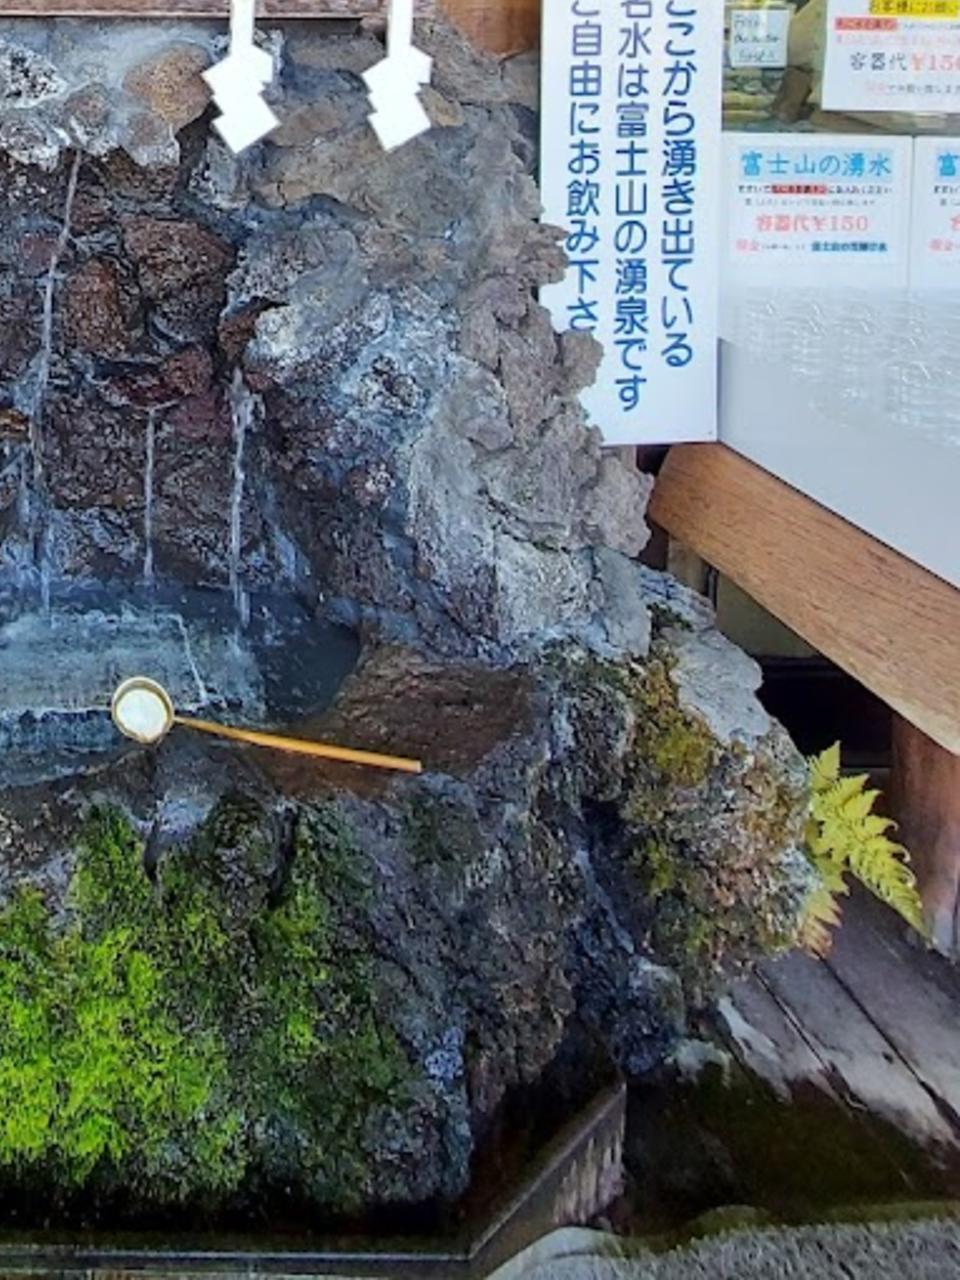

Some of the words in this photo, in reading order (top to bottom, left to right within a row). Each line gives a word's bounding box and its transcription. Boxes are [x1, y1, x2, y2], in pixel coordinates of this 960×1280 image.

[741, 150, 892, 177] 富士山の湧水
[755, 214, 869, 233] 容器代¥150
